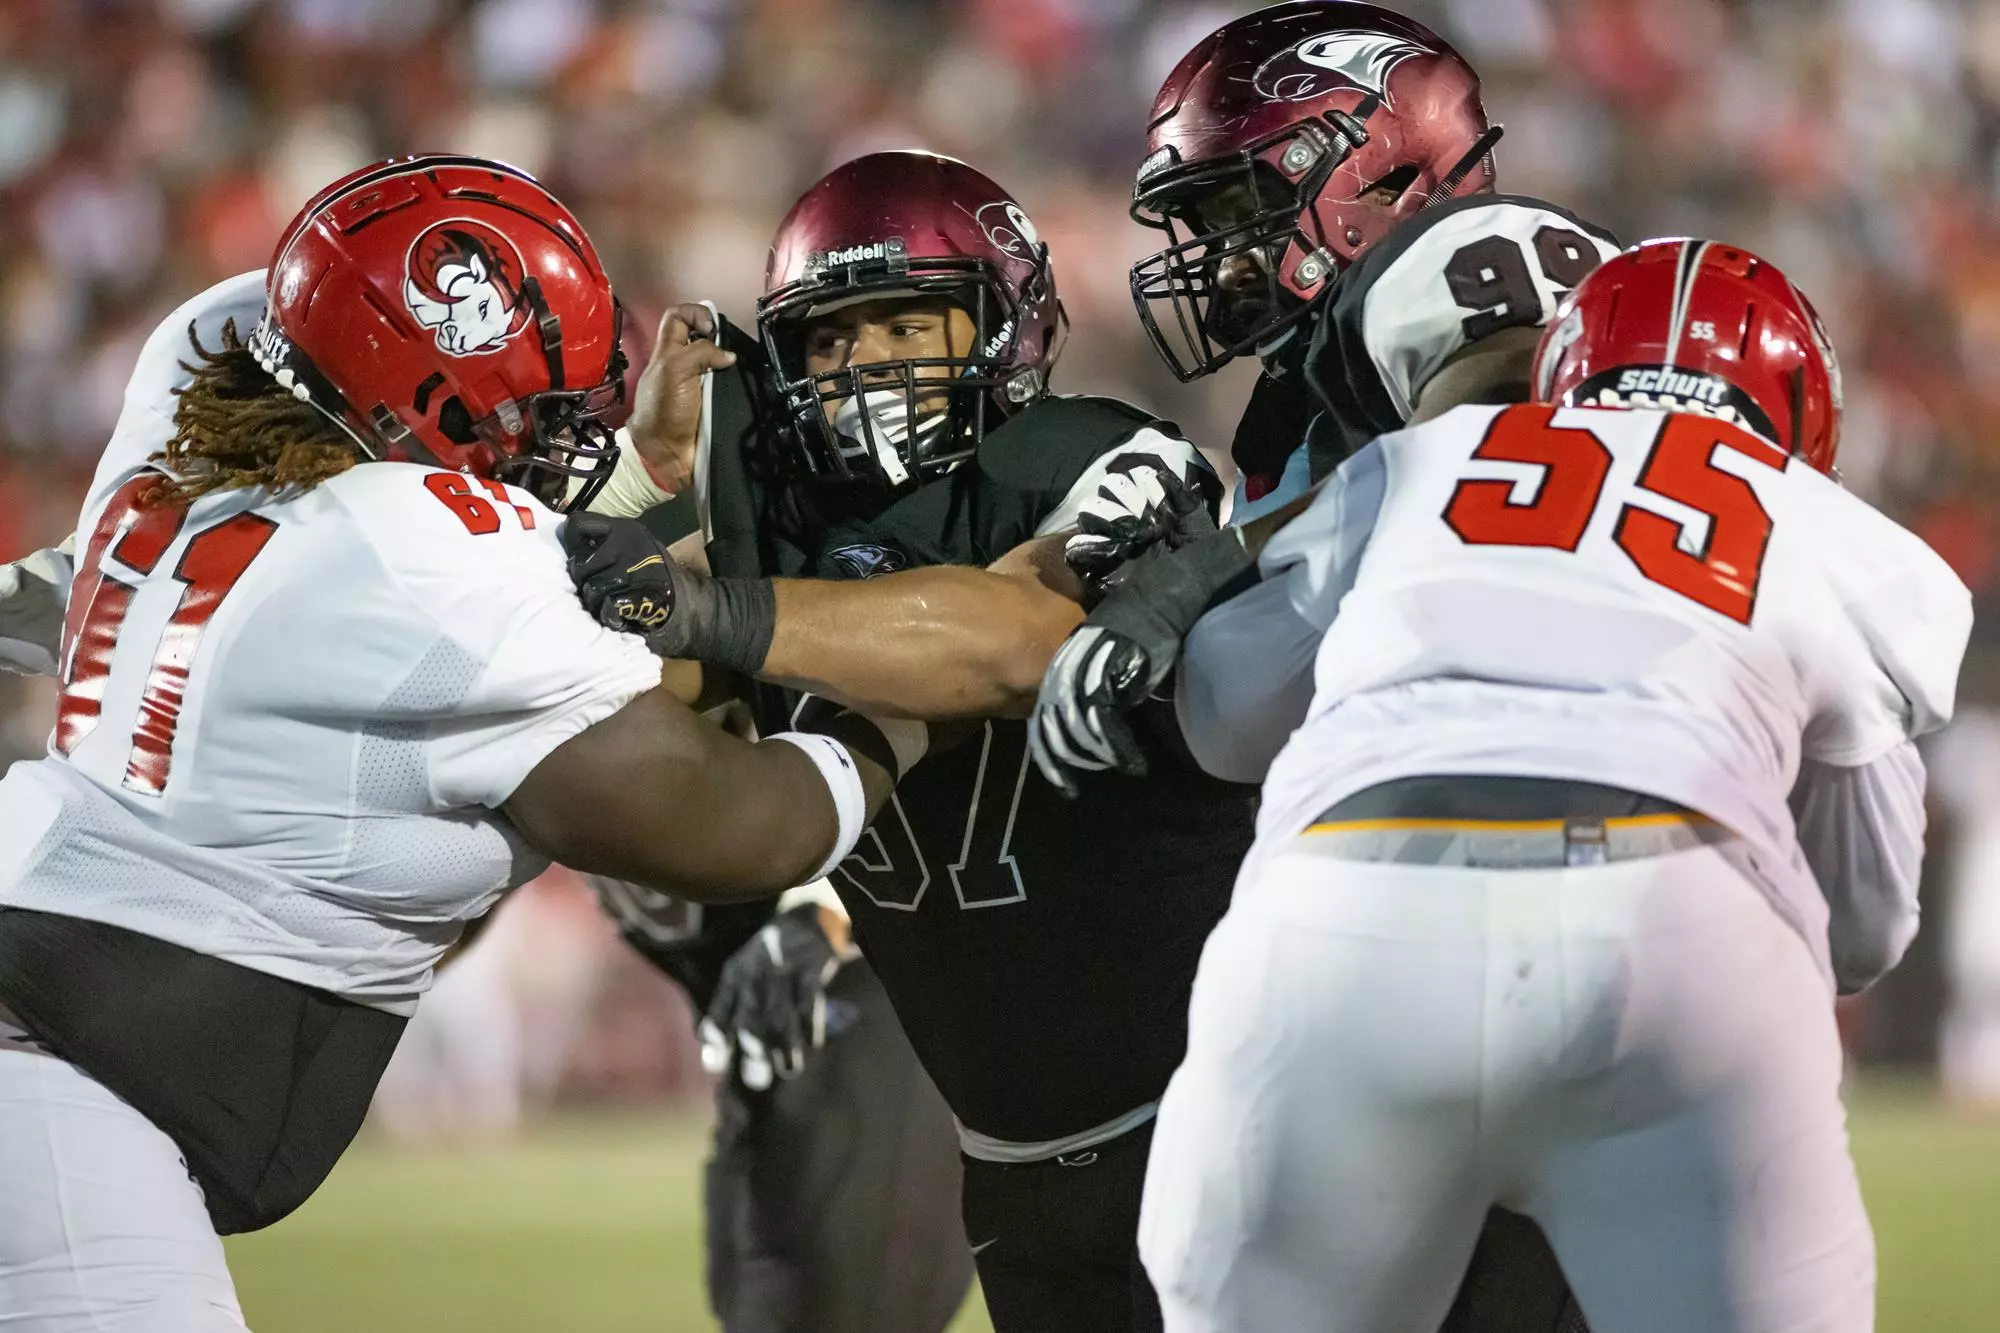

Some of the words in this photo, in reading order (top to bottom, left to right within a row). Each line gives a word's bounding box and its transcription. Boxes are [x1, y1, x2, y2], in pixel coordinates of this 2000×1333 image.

[828, 243, 884, 266] Riddell
[985, 320, 1014, 358] ddell
[1689, 321, 1715, 342] 55
[1617, 365, 1727, 404] schutt
[1440, 404, 1790, 622] 55
[55, 472, 280, 798] 61
